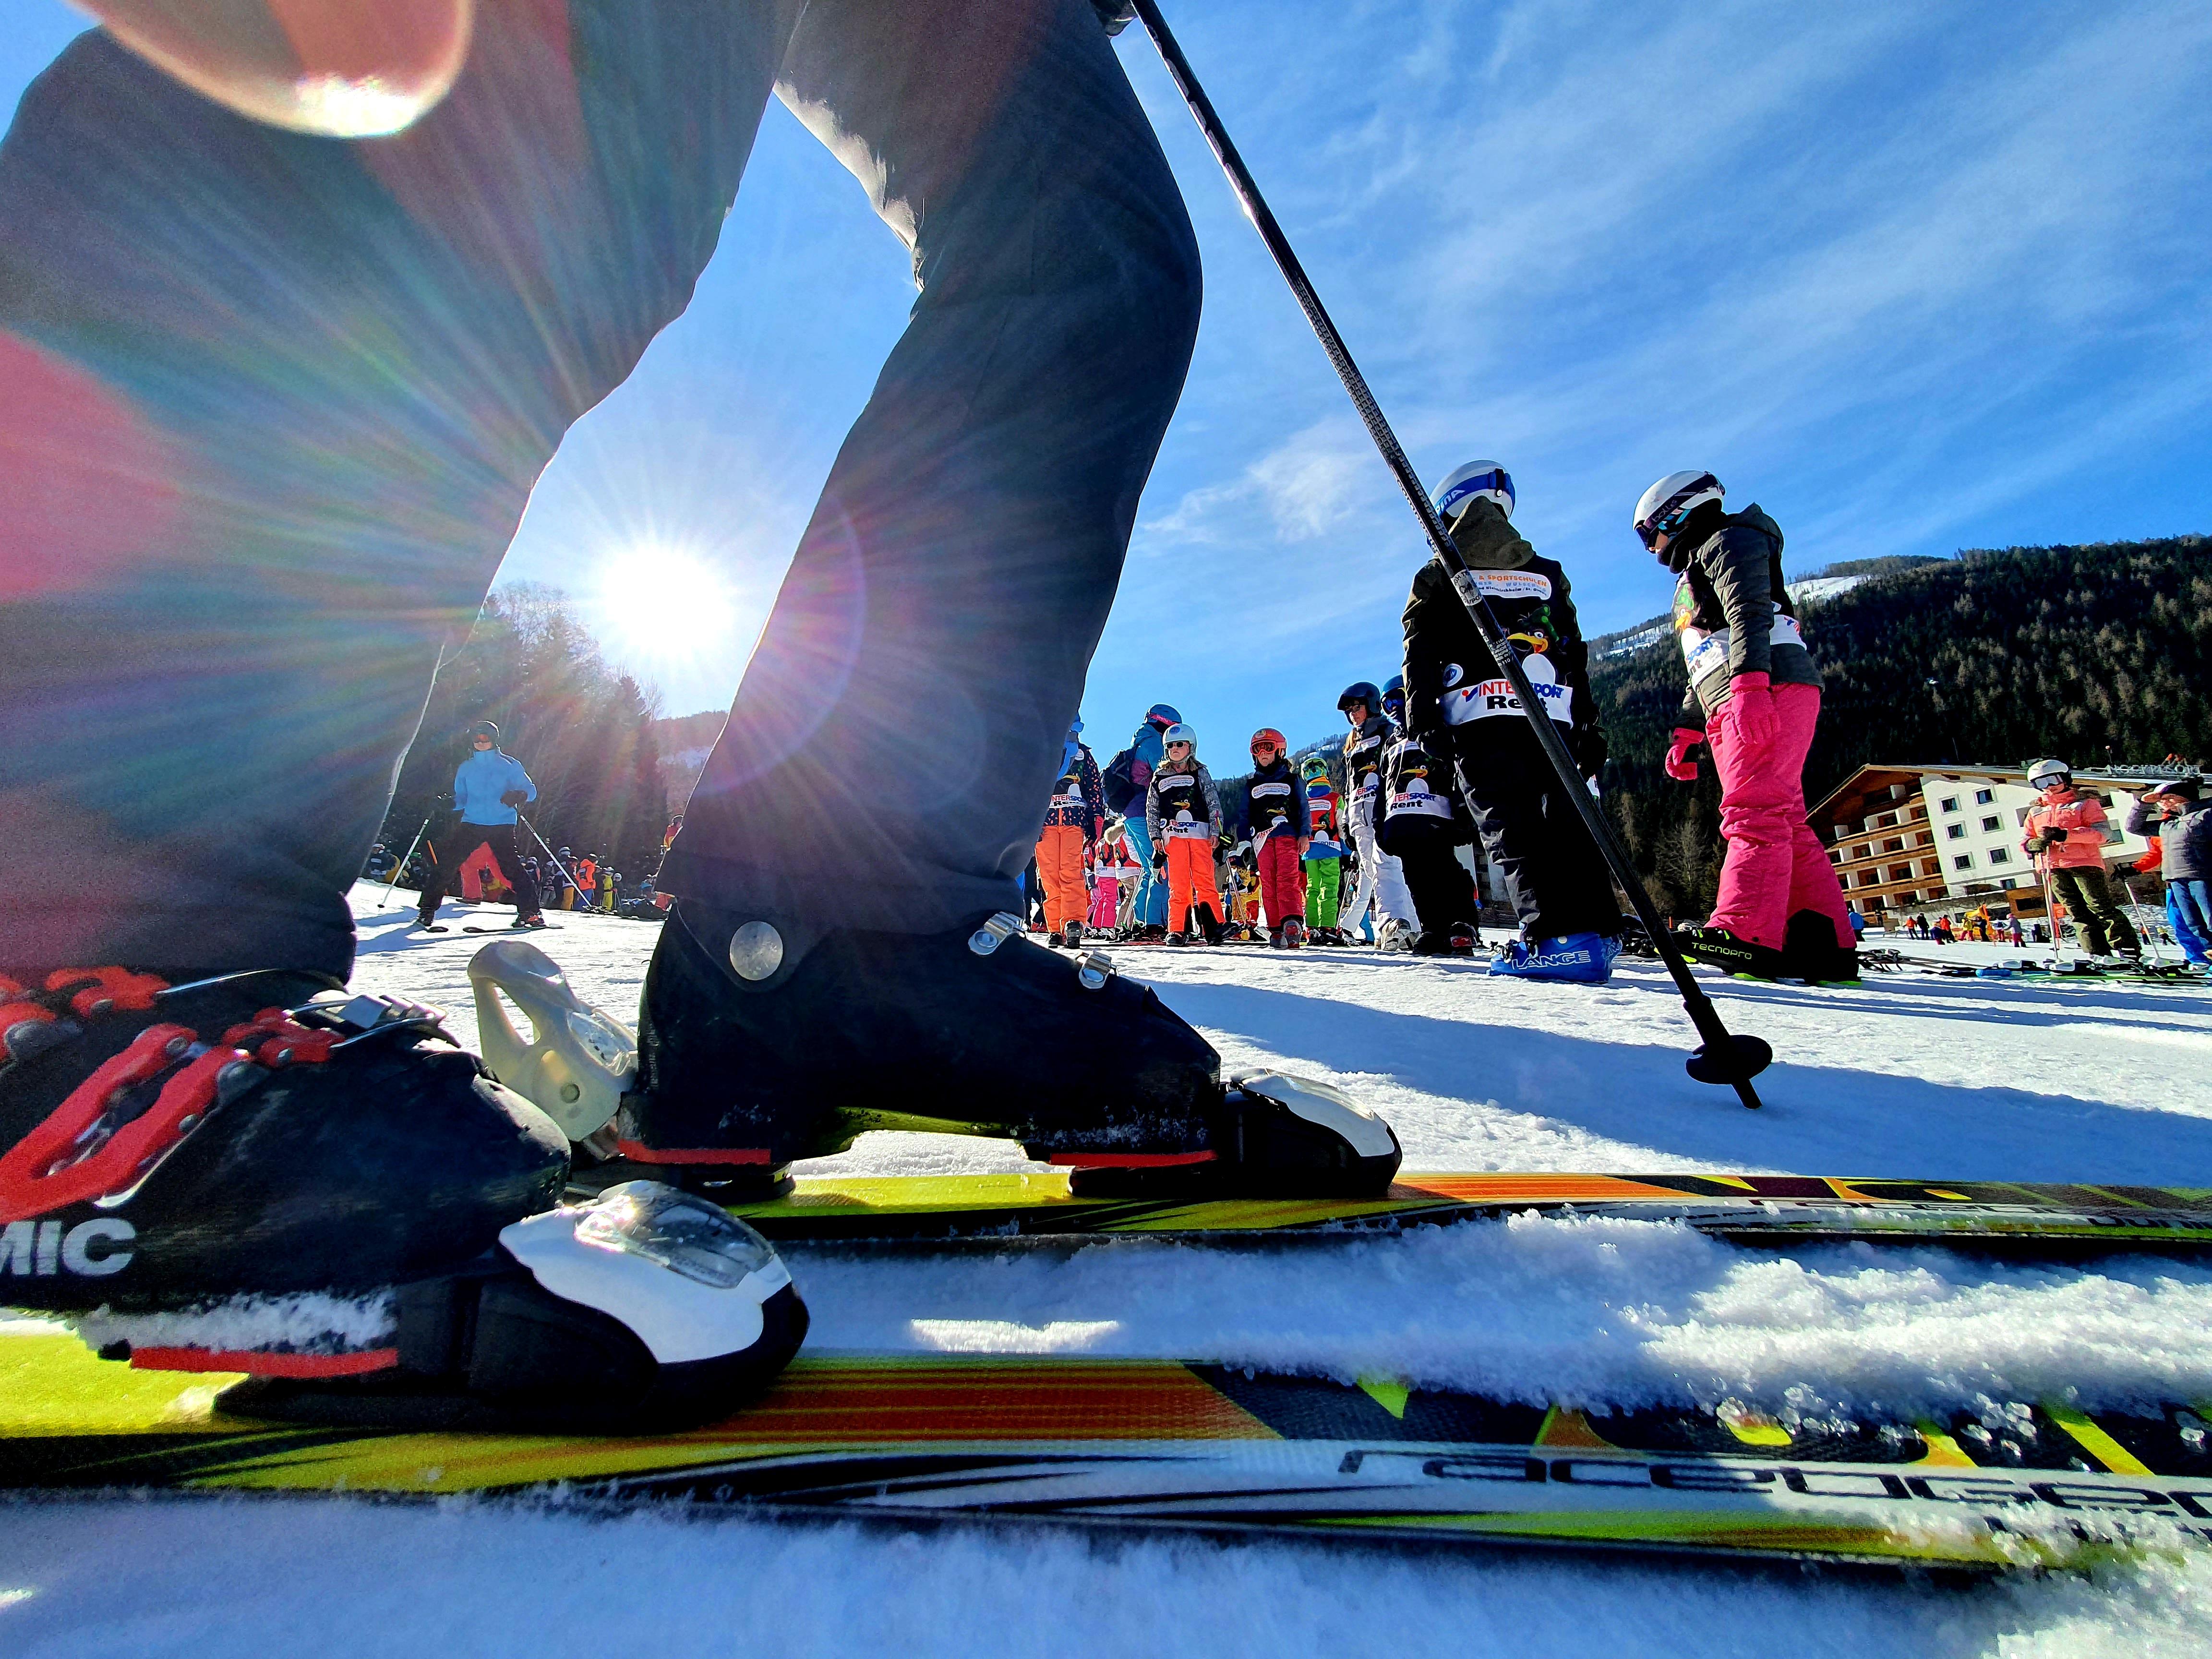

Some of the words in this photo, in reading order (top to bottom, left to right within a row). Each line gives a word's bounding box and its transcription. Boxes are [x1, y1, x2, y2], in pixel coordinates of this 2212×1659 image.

[1487, 574, 1547, 587] SPORTSCHULEN
[1479, 681, 1565, 699] INTESPORT
[1486, 695, 1548, 712] Ret
[1512, 950, 1591, 970] LANGE
